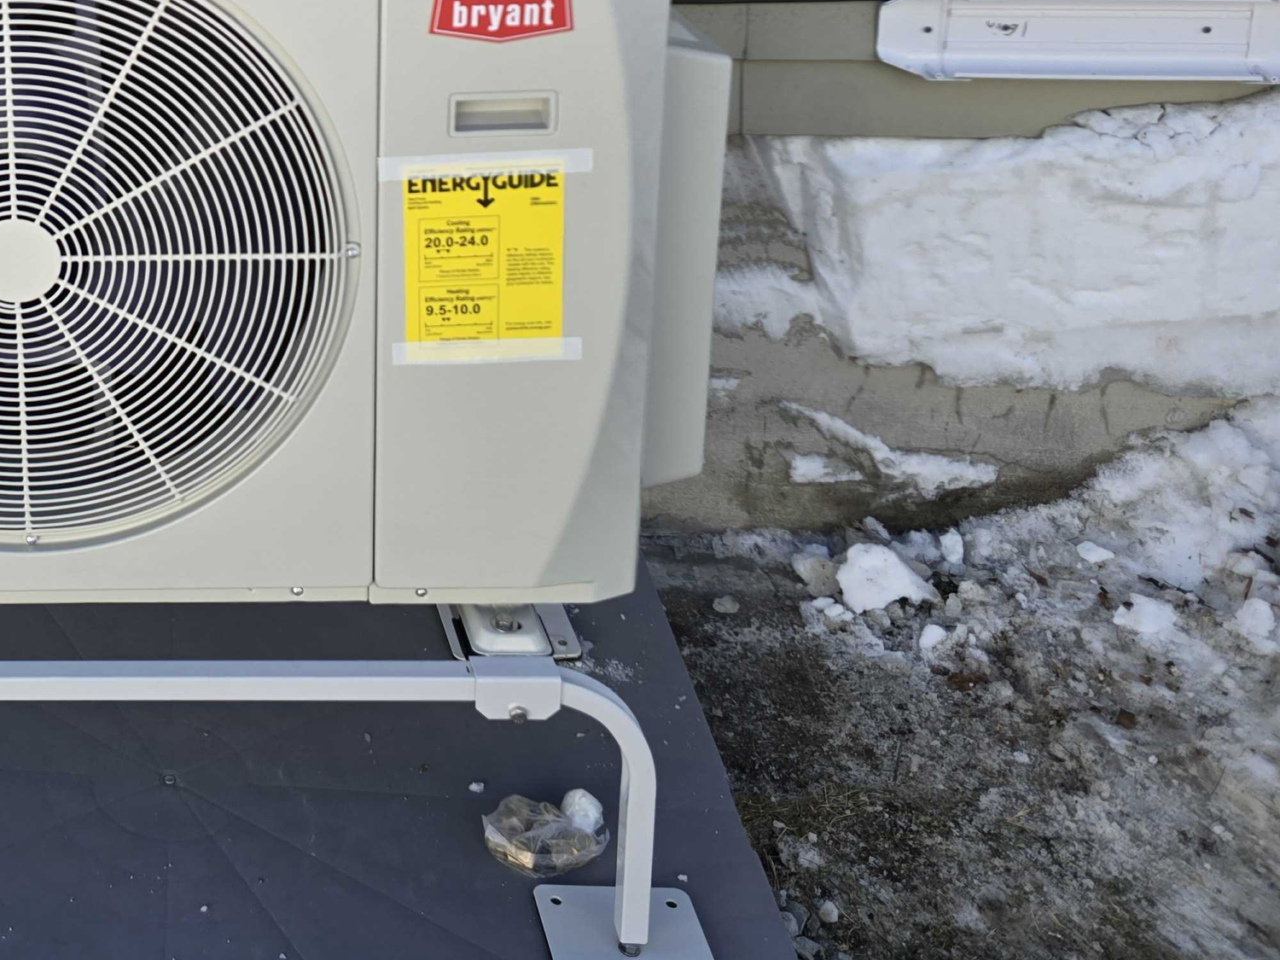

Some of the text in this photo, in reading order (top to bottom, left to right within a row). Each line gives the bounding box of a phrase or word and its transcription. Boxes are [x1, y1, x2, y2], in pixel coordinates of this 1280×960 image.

[452, 0, 554, 31] bryant
[424, 228, 454, 236] Efficiency
[456, 226, 476, 235] Rating
[424, 234, 489, 248] 20.0-24.0
[424, 295, 454, 304] Efficiency
[456, 294, 476, 303] Rating
[426, 303, 481, 316] 9.5-10.0
